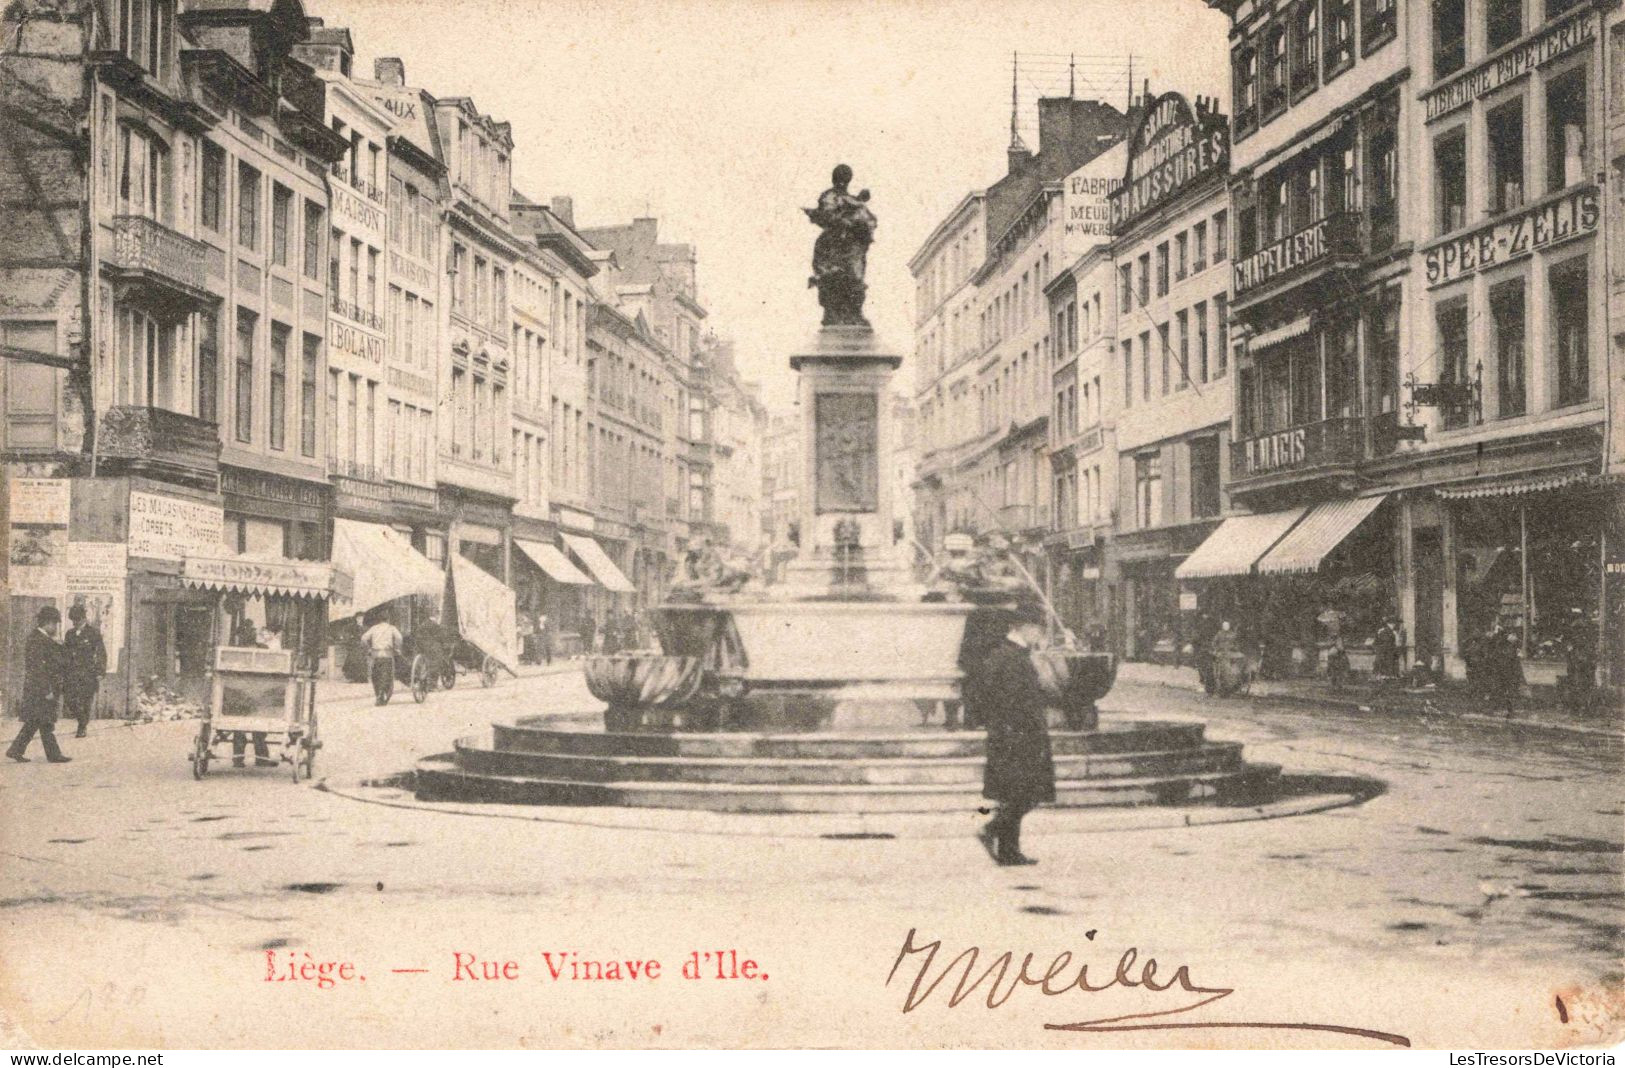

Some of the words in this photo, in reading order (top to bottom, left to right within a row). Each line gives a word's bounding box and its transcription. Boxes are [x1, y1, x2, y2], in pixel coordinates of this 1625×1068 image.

[1426, 70, 1491, 119] LIBRAIRIE
[1497, 17, 1593, 84] PAPETERIE
[1112, 130, 1222, 226] CHAUSSURES
[1426, 195, 1600, 285] SPEE-ZELIS
